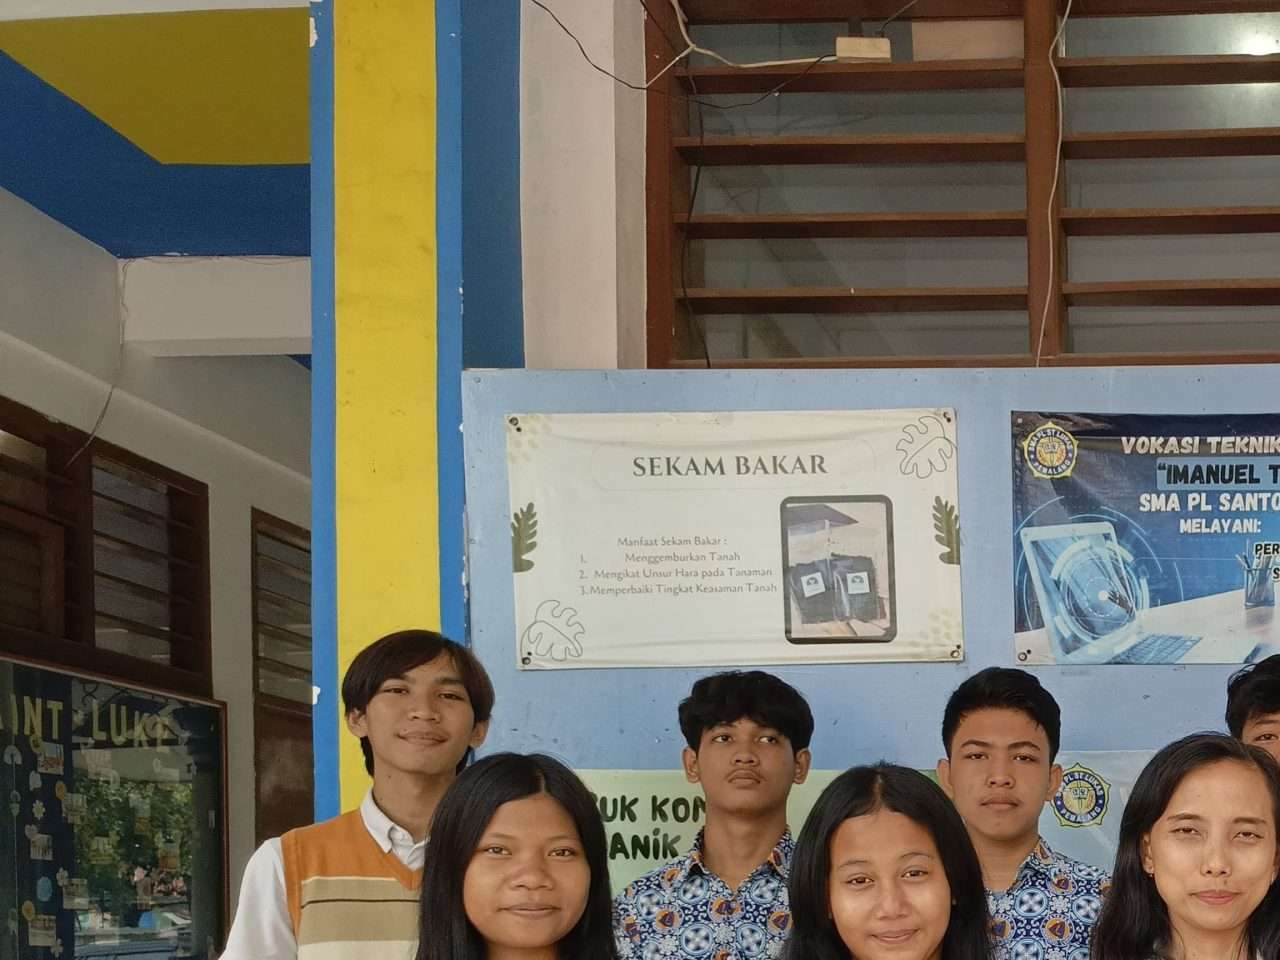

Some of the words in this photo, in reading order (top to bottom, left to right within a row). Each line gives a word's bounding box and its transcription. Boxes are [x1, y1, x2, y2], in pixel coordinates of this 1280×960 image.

[1121, 435, 1199, 455] VOKASI
[633, 456, 726, 478] SEKAM
[736, 454, 828, 476] BAKAR
[1139, 493, 1181, 512] SMA
[1187, 493, 1212, 512] PL
[1179, 517, 1262, 535] MELAYANI:
[617, 536, 658, 548] Manfaat
[660, 536, 691, 547] Sekam
[694, 536, 721, 546] Bakar
[624, 552, 706, 565] Menggemburkan
[709, 551, 741, 562] Tanah
[594, 569, 640, 582] Mengikat
[643, 569, 672, 578] Unsur
[675, 568, 699, 578] Hara
[701, 568, 725, 580] pada
[727, 567, 772, 578] Tanaman
[656, 584, 693, 596] Tingkat
[696, 582, 743, 594] Keasaman
[746, 582, 777, 593] Tanah
[0, 693, 64, 741] INT
